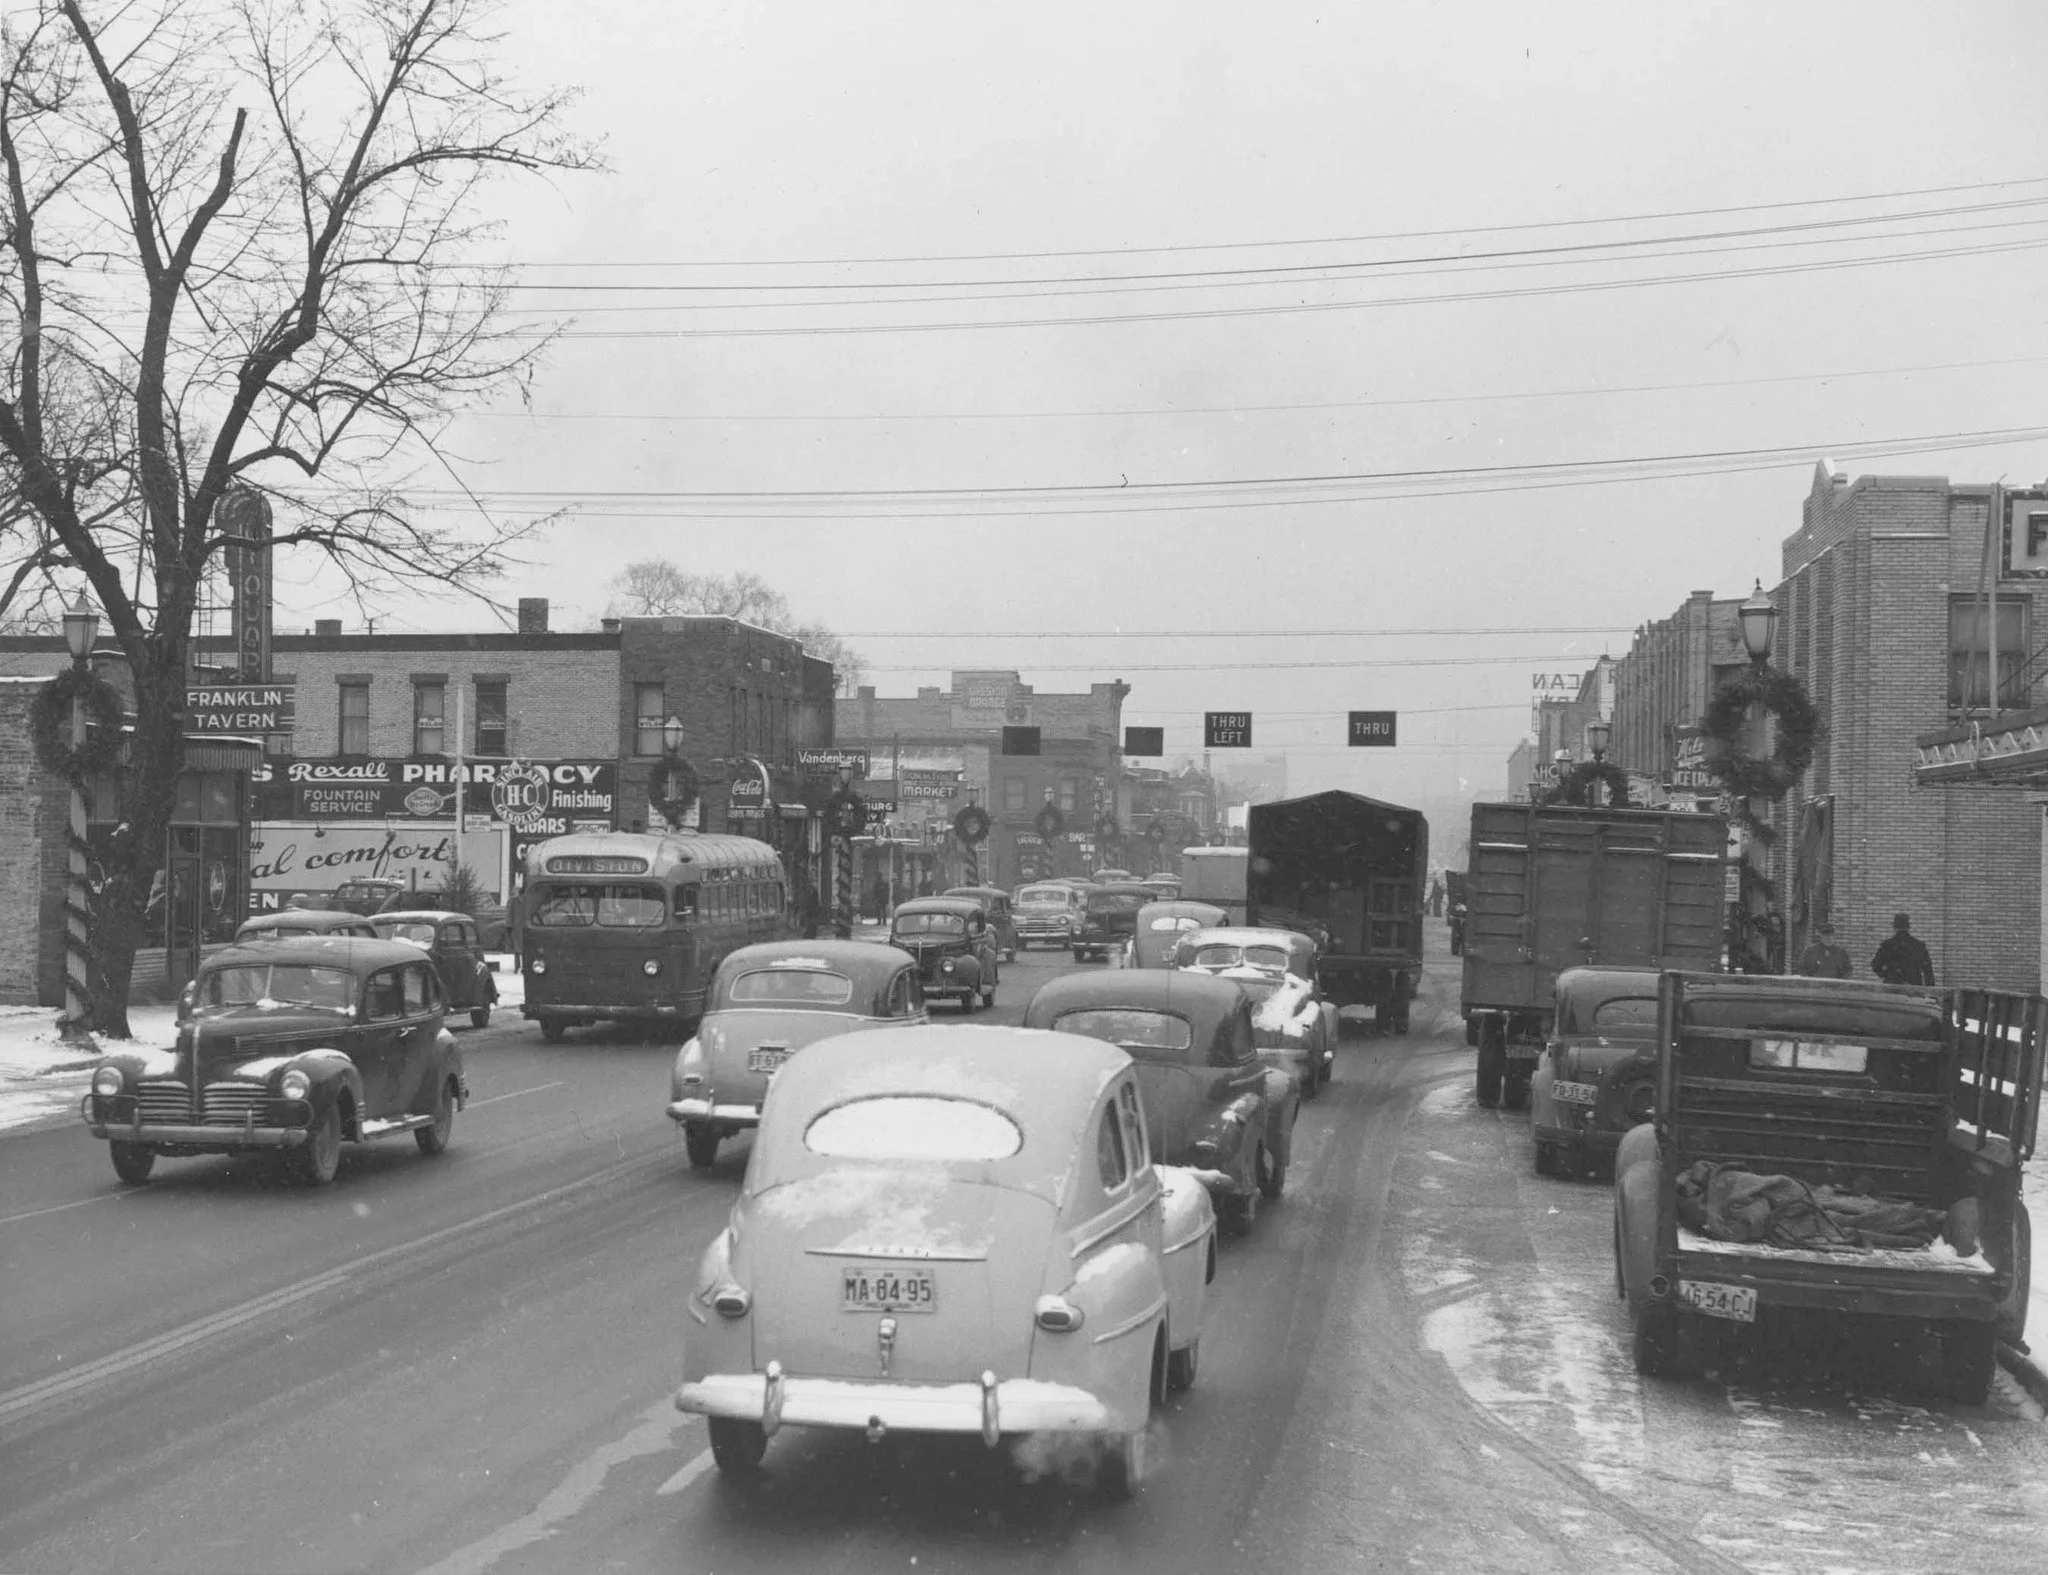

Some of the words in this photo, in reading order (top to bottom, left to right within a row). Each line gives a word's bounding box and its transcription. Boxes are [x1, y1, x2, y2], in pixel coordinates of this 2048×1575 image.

[187, 691, 282, 706] FRANKLIN
[194, 712, 274, 728] TAVERN
[1211, 715, 1245, 728] THRU
[1354, 722, 1389, 735] THRU
[1214, 731, 1242, 744] LEFT
[288, 762, 390, 783] Rexall
[303, 789, 381, 801] FOUNTAIN
[902, 786, 954, 798] MARKET
[309, 801, 374, 813] SERVICE
[552, 789, 612, 812] Finishing
[553, 859, 642, 872] DIVISION
